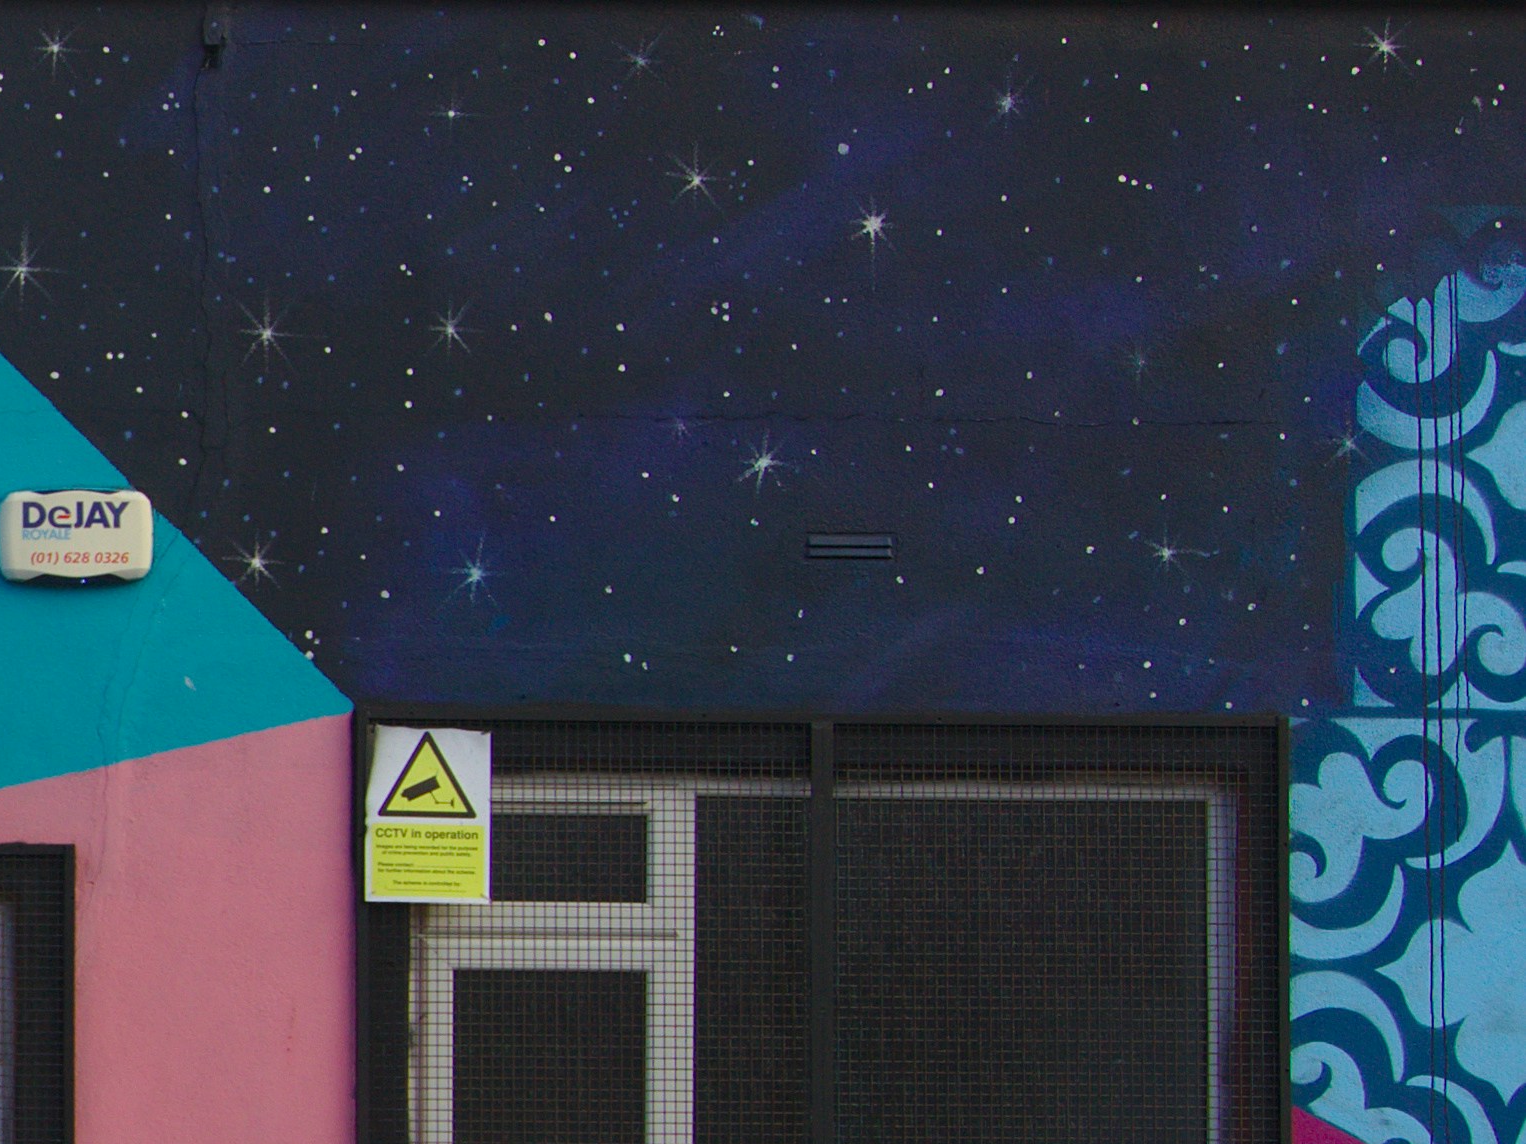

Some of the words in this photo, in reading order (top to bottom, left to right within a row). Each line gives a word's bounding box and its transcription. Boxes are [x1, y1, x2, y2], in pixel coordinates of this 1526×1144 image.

[22, 501, 130, 528] DeJAY
[22, 528, 71, 540] ROYALE
[30, 552, 59, 565] (01)
[63, 552, 90, 563] 628
[95, 552, 130, 563] 0326
[375, 827, 408, 838] CCTV
[411, 828, 422, 839] in
[425, 829, 479, 840] operation
